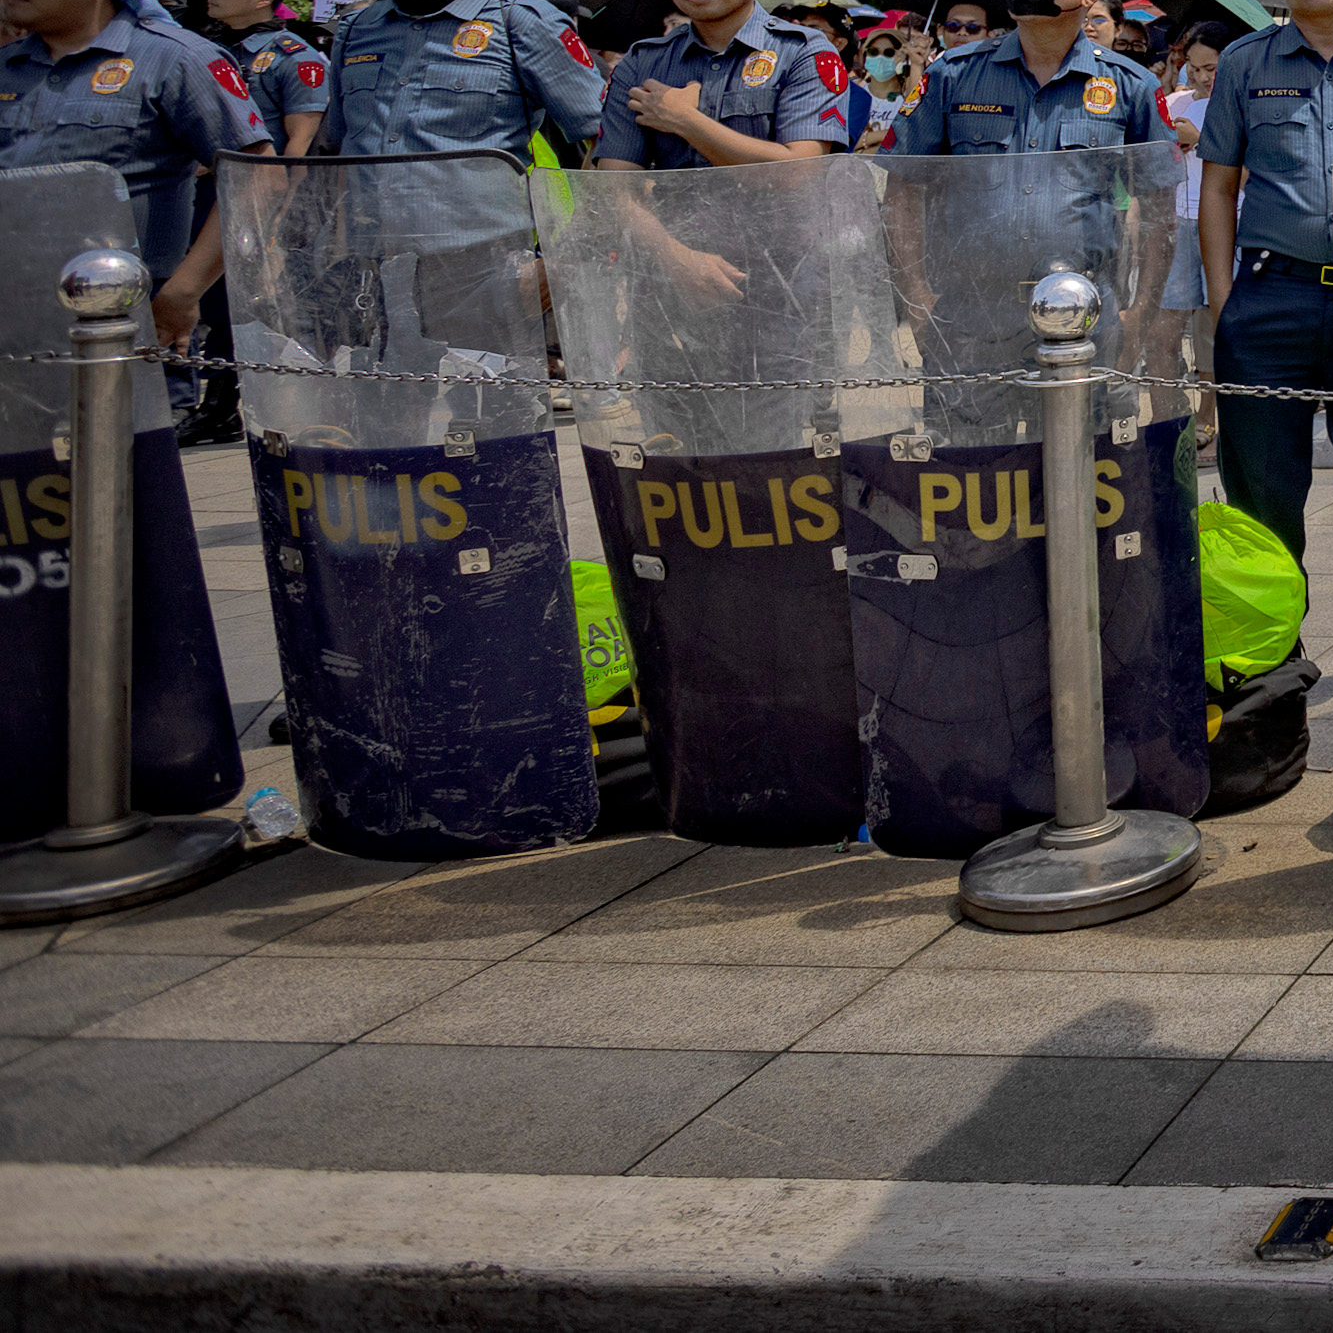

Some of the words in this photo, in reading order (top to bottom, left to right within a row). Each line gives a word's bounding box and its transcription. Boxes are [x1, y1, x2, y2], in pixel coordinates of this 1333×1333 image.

[959, 104, 1002, 114] MENDOZA
[1258, 89, 1301, 97] APOSTOL
[283, 469, 470, 545] PULIS
[638, 473, 840, 549] PULIS
[918, 459, 1125, 542] PULS
[584, 674, 599, 685] GH
[603, 663, 629, 677] VISIB
